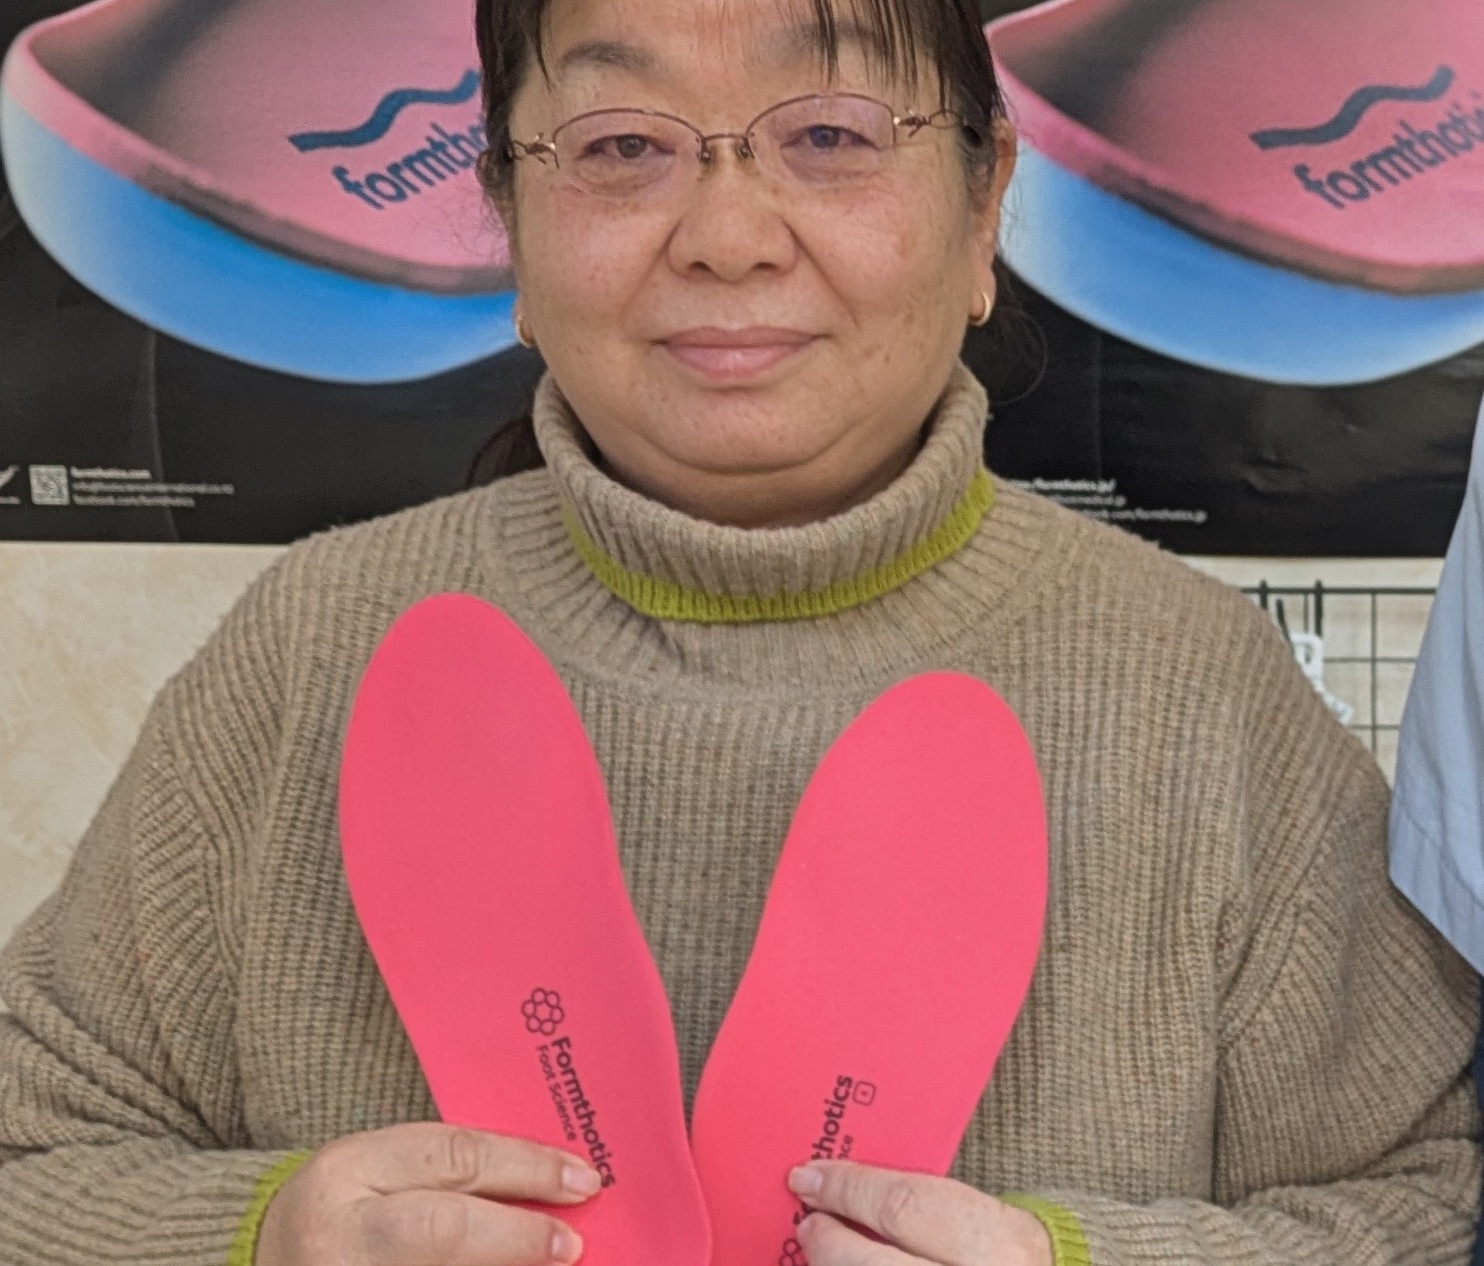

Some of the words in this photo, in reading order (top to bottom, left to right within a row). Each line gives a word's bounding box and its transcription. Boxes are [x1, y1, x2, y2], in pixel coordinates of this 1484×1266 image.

[537, 1044, 556, 1081] Foot
[548, 1082, 577, 1141] Science
[551, 1036, 616, 1188] Formthotics
